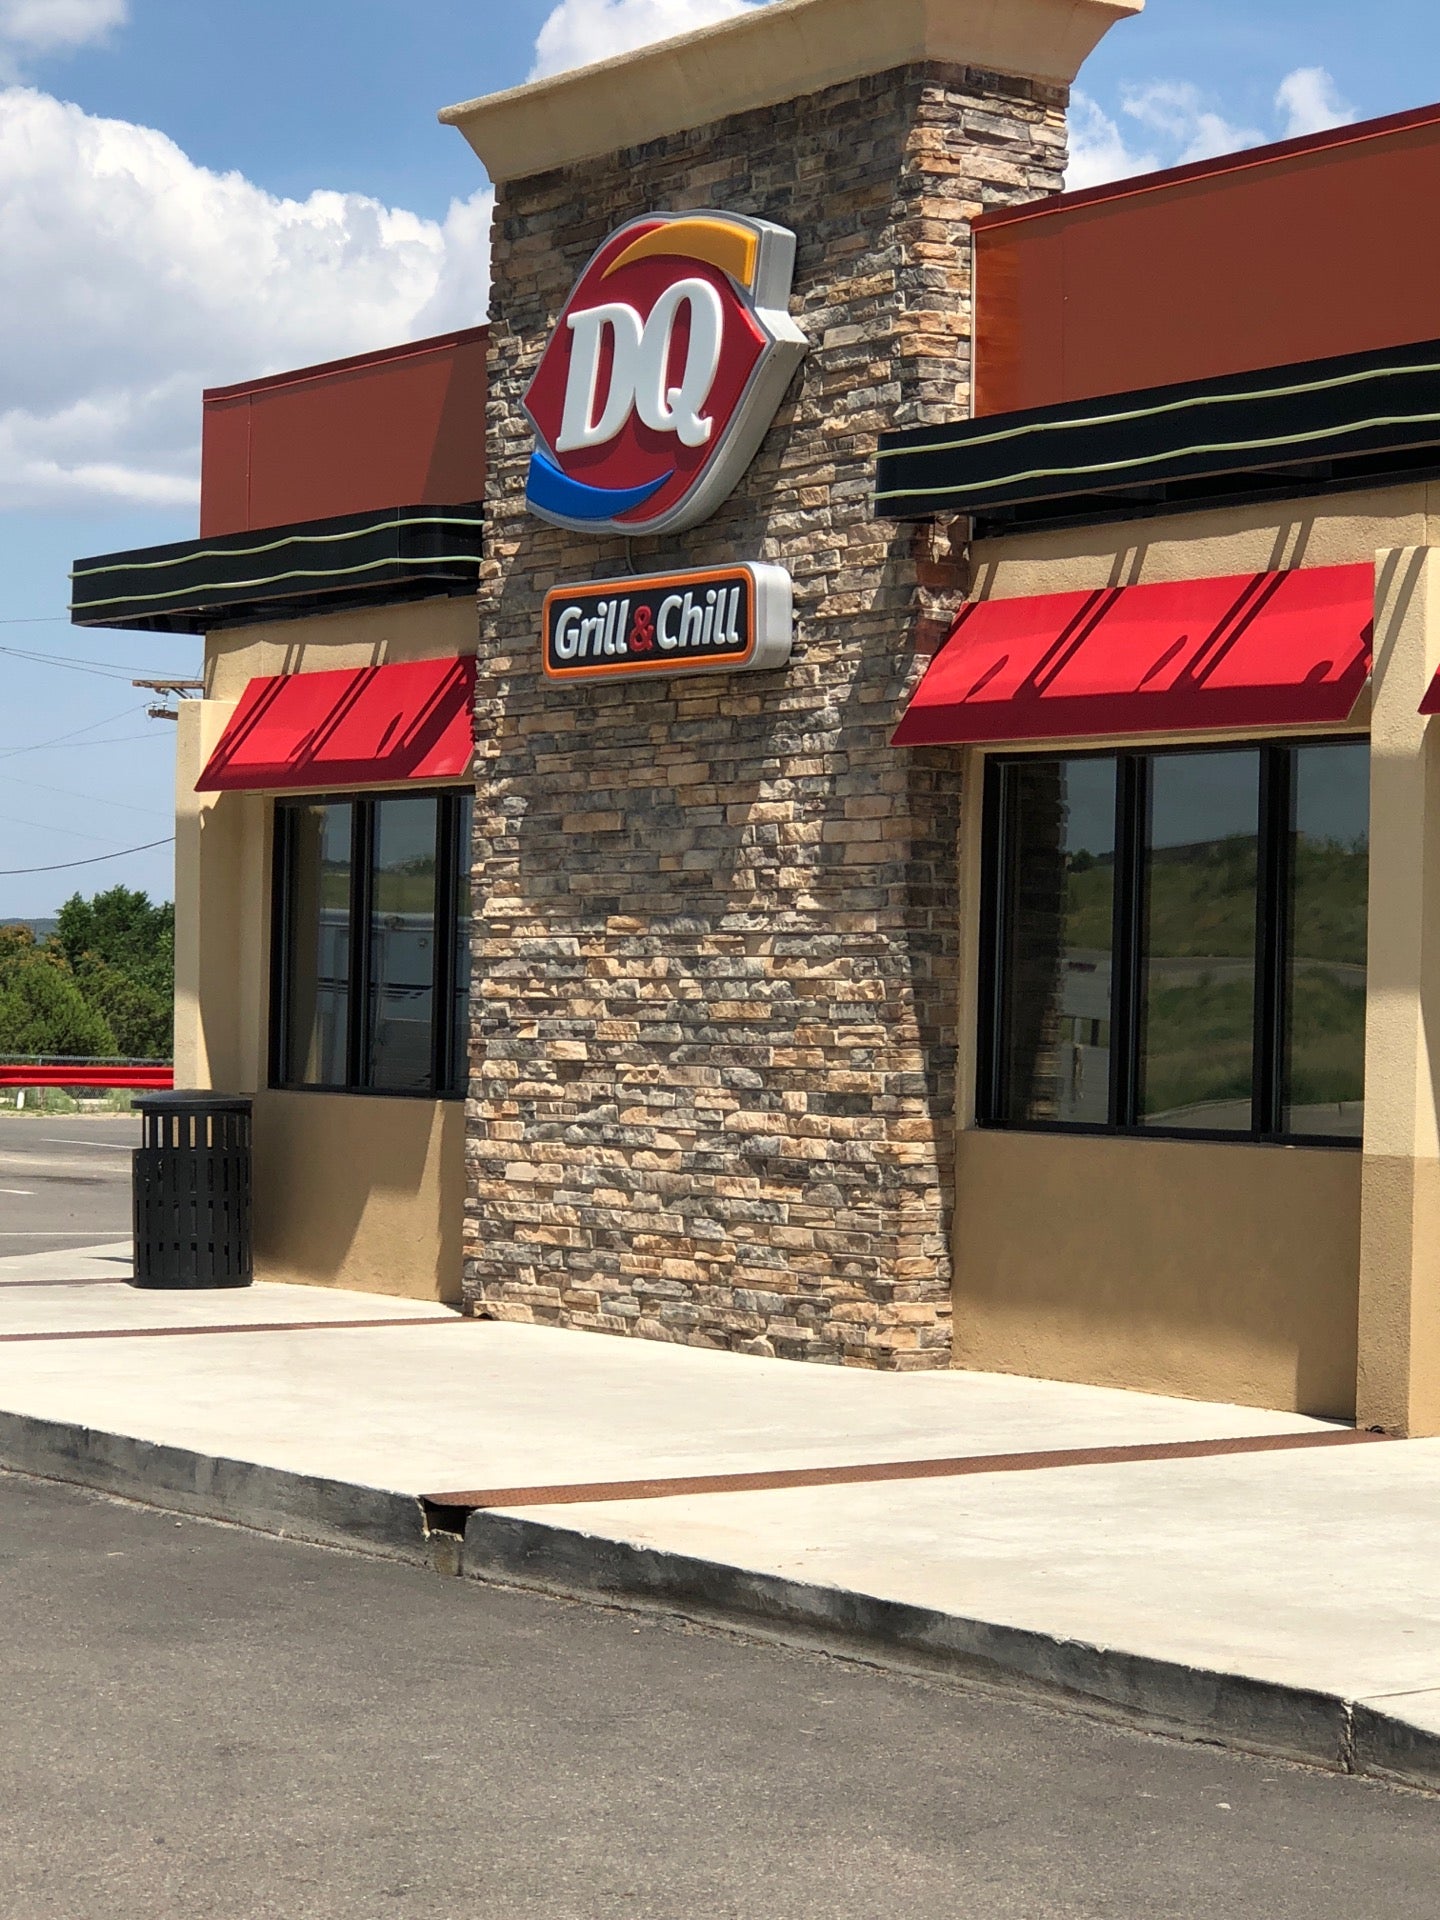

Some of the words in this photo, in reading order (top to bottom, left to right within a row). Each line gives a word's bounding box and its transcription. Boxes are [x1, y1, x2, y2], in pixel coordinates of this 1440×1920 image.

[555, 277, 724, 453] DQ
[555, 599, 630, 660] Grill
[630, 605, 654, 653] &
[656, 586, 740, 650] Chill
